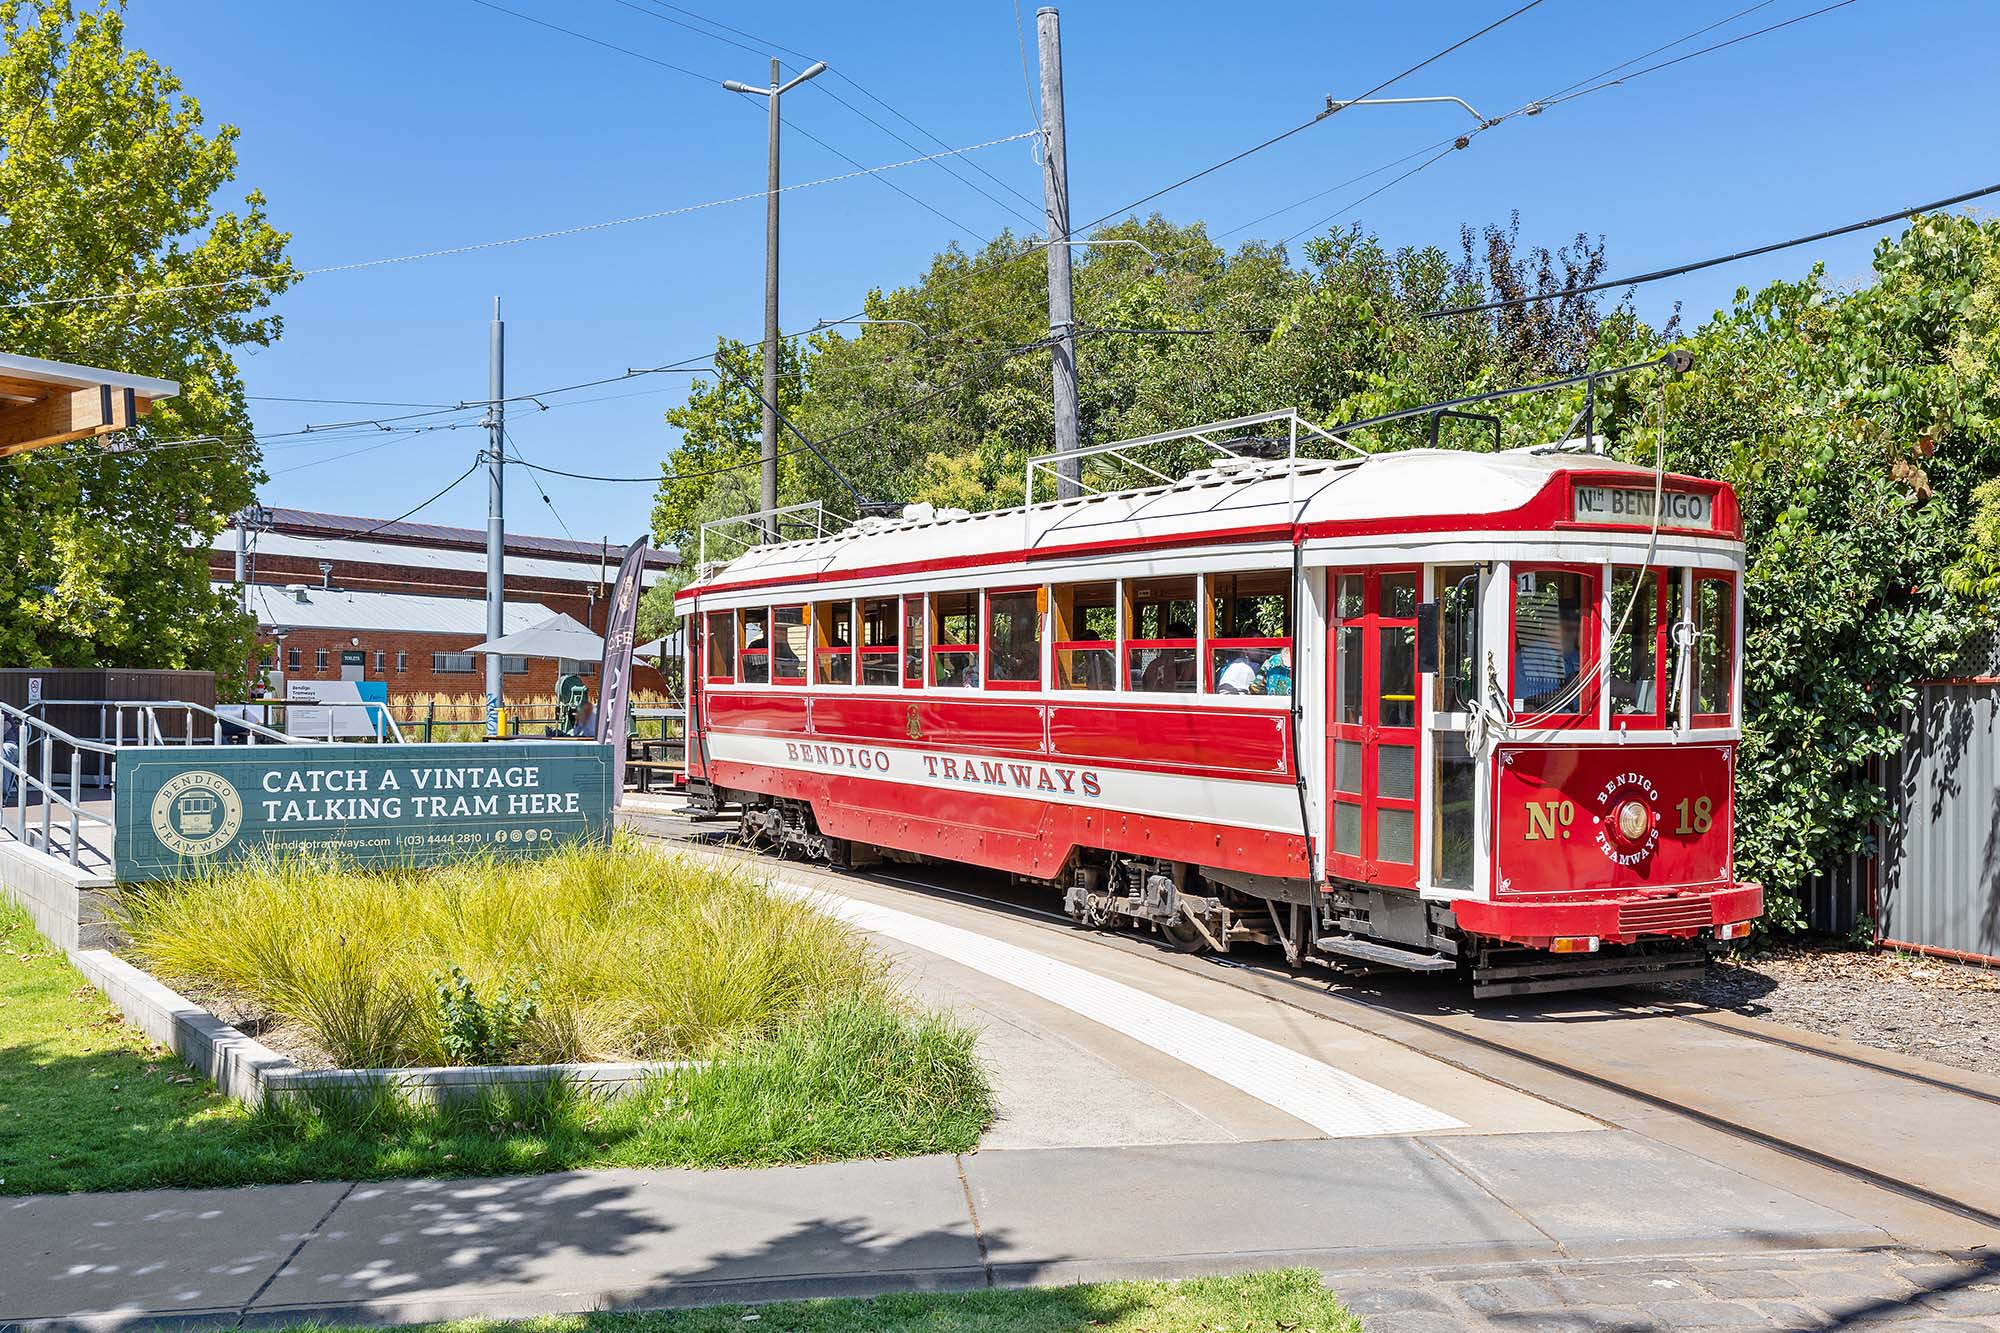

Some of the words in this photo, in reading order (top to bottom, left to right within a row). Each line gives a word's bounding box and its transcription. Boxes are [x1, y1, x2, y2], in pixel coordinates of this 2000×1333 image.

[1612, 489, 1702, 520] BENDIGO
[1521, 574, 1532, 592] 1
[262, 769, 368, 793] CATCH
[378, 769, 400, 791] A
[411, 767, 539, 790] VINTAGE
[785, 742, 891, 772] BENDIGO
[923, 755, 1102, 797] TRAMWAYS
[163, 775, 231, 799] BENDIGO
[1597, 772, 1658, 805] BENDIGO
[262, 797, 401, 822] TALKING
[411, 795, 499, 818] TRAM
[508, 793, 579, 815] HERE
[1674, 796, 1713, 835] 18
[158, 820, 236, 852] TRAMWAYS
[403, 835, 425, 847] (03)
[427, 834, 454, 844] 4444
[457, 833, 482, 843] 2810
[1595, 828, 1659, 866] TRAMWAYS
